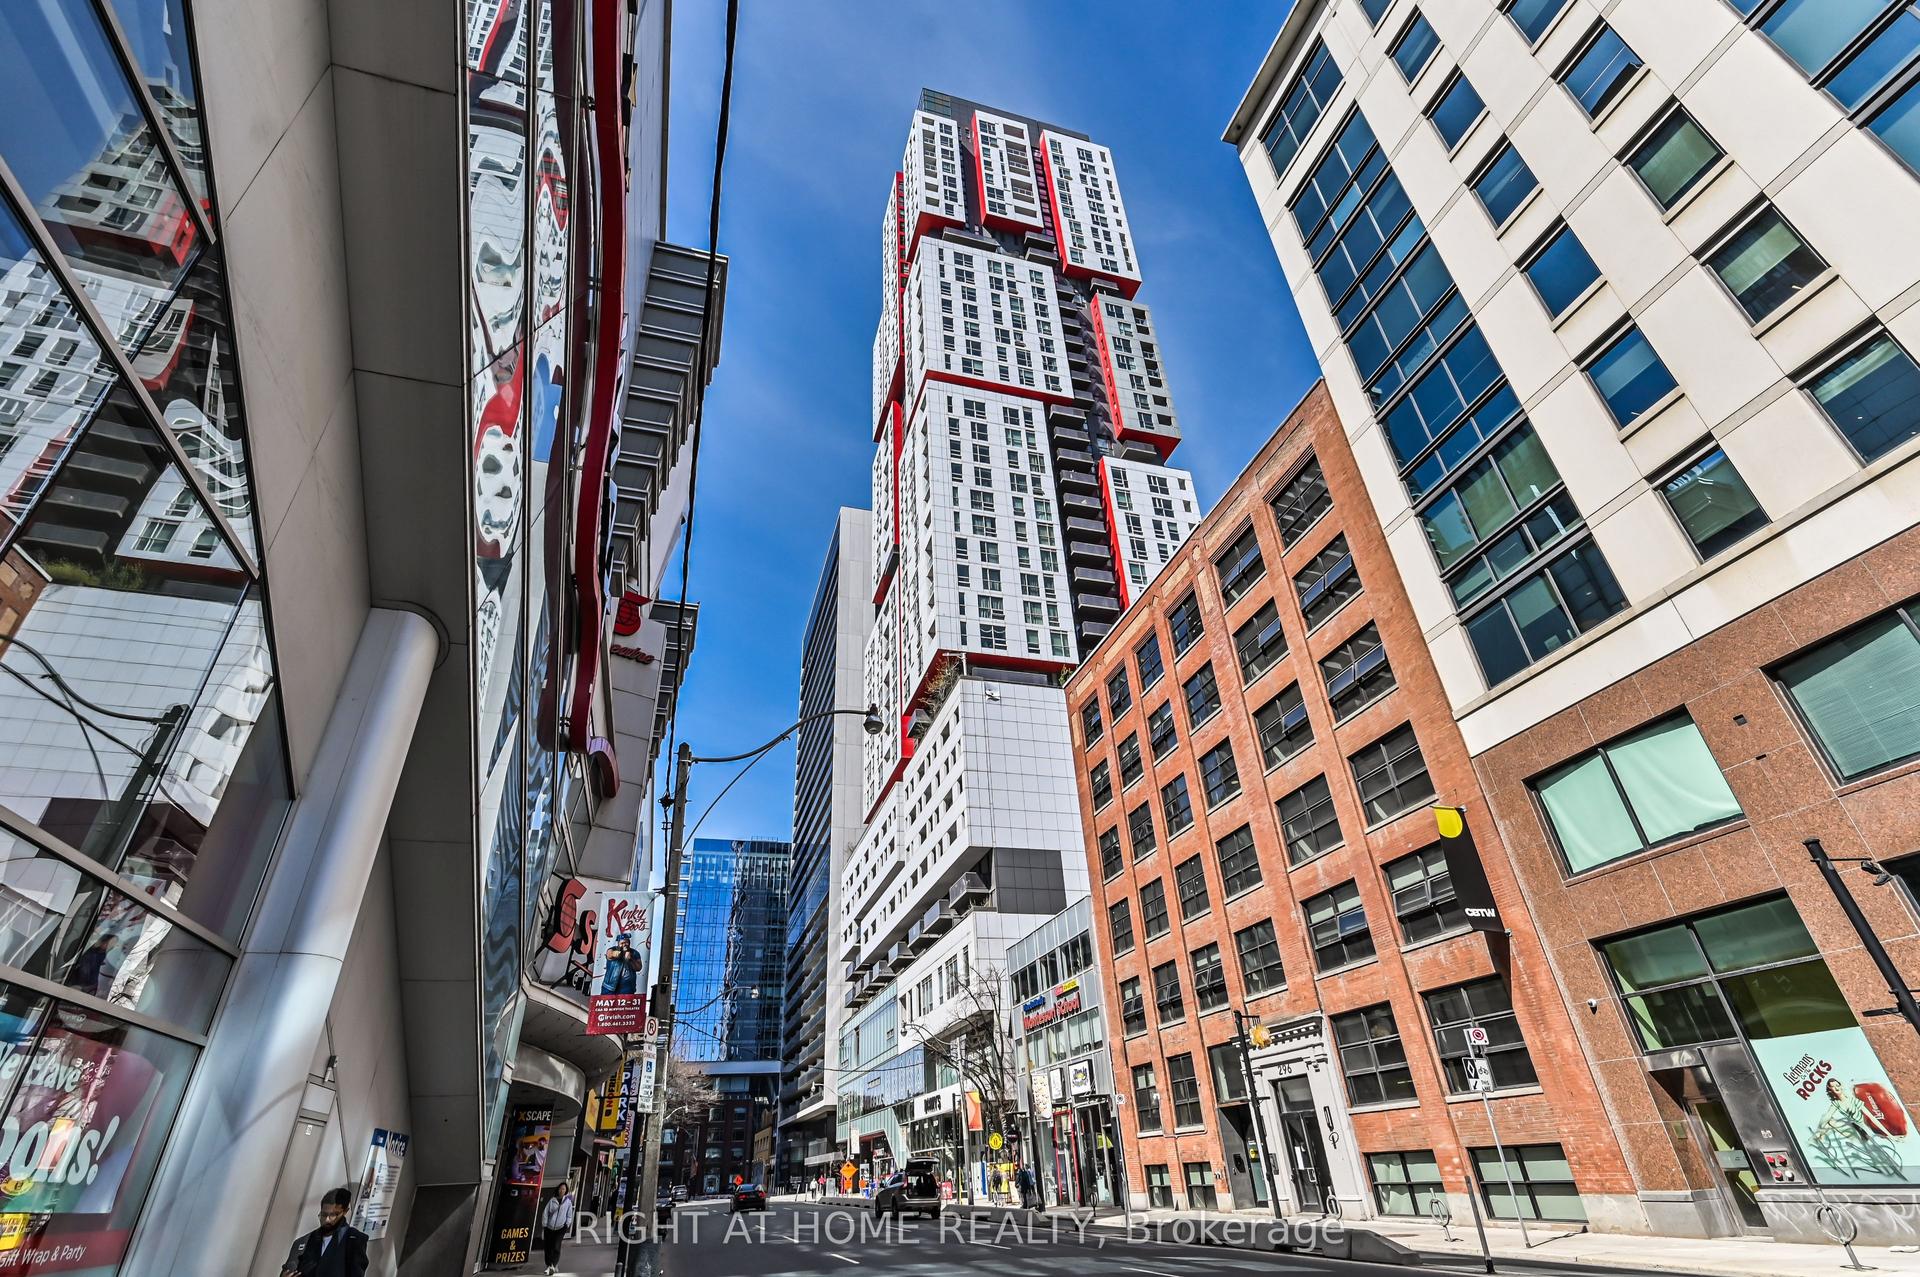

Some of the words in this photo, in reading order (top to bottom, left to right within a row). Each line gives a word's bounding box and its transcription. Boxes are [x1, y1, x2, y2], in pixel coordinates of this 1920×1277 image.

[606, 898, 646, 938] Kinky
[1465, 907, 1496, 918] CBTW
[624, 920, 650, 932] Boots
[595, 999, 616, 1007] MAY
[1057, 992, 1080, 1018] School
[597, 1013, 637, 1021] mirvish.com
[1278, 1065, 1292, 1076] 296
[1796, 1060, 1832, 1101] ROCKS
[618, 1071, 631, 1121] PARK
[519, 1110, 552, 1122] XSCAPE
[384, 1130, 406, 1157] Notice
[501, 1227, 529, 1239] GAMES
[509, 1239, 516, 1251] &
[21, 1248, 50, 1267] Wrap
[51, 1245, 60, 1261] &
[60, 1244, 87, 1262] Party
[495, 1251, 526, 1264] PRIZES
